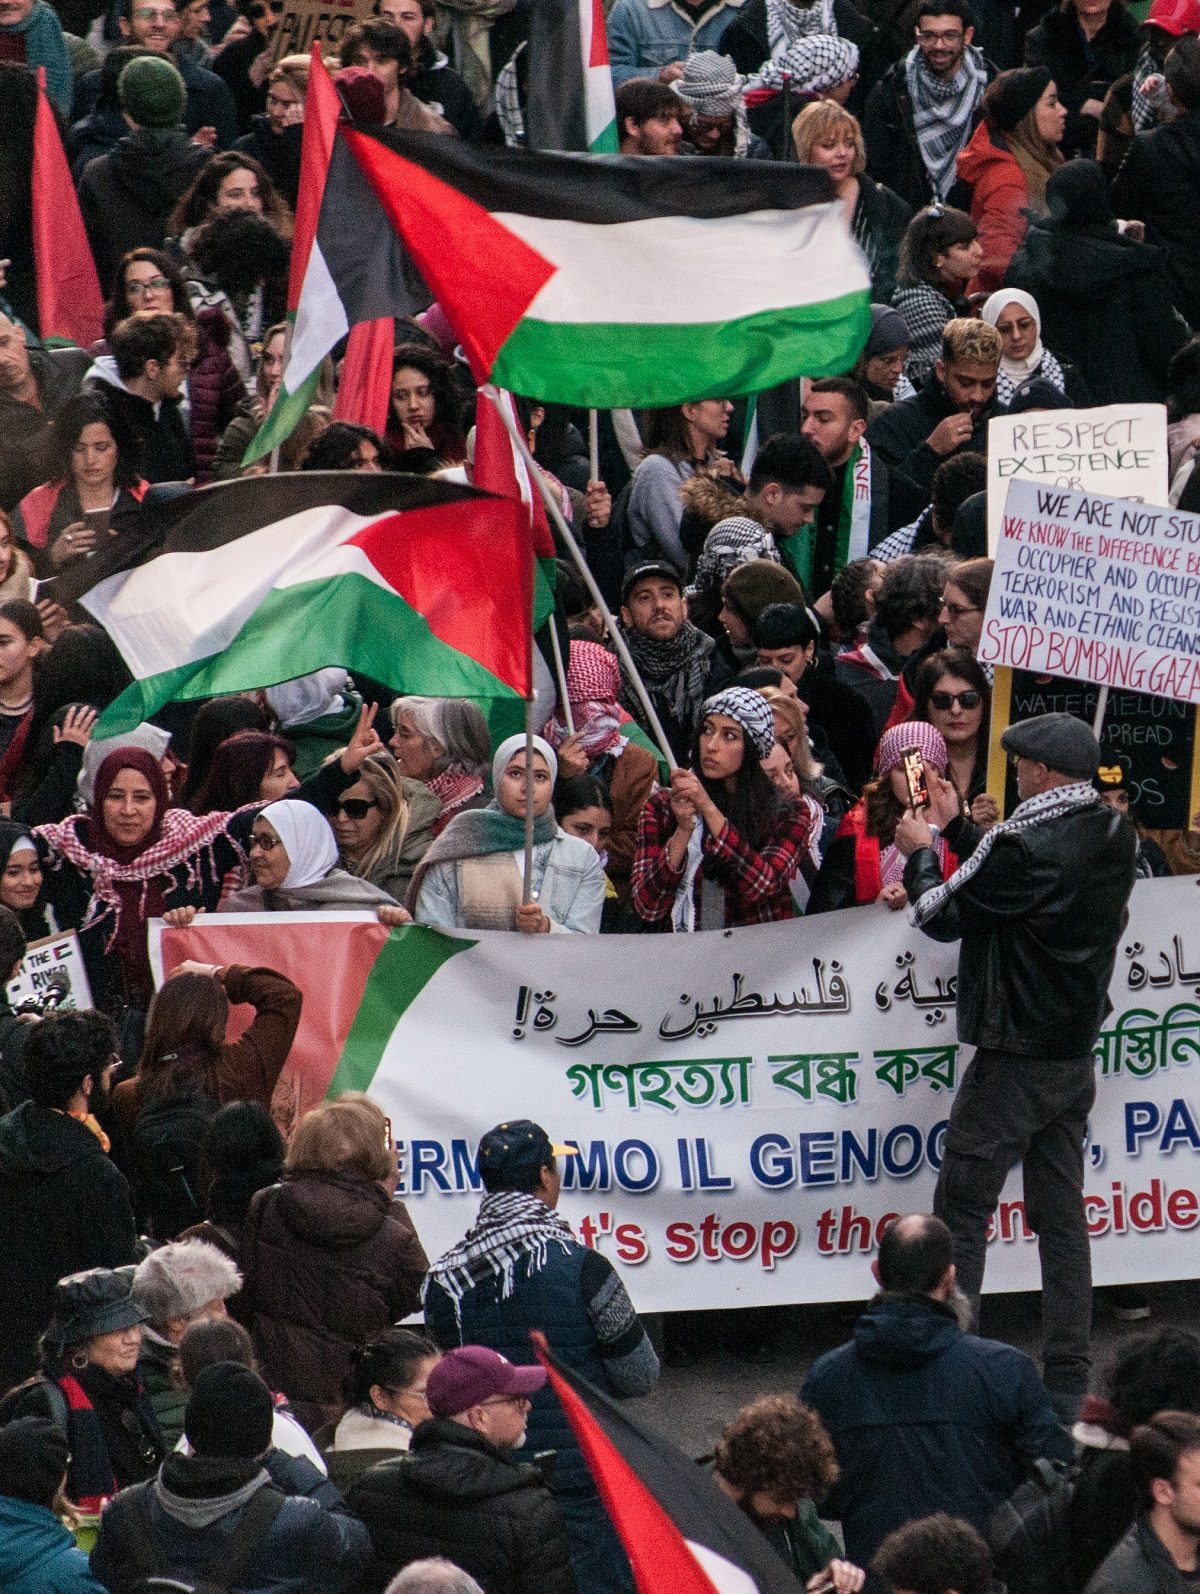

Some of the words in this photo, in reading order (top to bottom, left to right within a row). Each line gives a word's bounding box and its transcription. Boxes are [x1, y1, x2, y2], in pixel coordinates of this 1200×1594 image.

[1012, 418, 1142, 451] RESPECT
[998, 449, 1155, 477] EXISTENCE
[1036, 489, 1071, 517] WE
[1074, 497, 1114, 528] ARE
[1120, 511, 1163, 537] NOT
[1002, 515, 1023, 541] WE
[1029, 520, 1071, 547] KNOW
[1070, 531, 1094, 553] THE
[1098, 535, 1180, 570] DIFFERENCE
[1017, 545, 1097, 581] OCCUPIER
[1104, 565, 1138, 590] AND
[1001, 570, 1101, 608] TERRORISM
[1109, 592, 1144, 617] AND
[999, 595, 1038, 625] WAR
[1044, 607, 1077, 628] AND
[1078, 610, 1143, 643] ETHNIC
[981, 619, 1043, 668] STOP
[1046, 632, 1149, 688] BOMBING
[1099, 723, 1172, 746] PREAD
[28, 950, 50, 967] THE
[658, 957, 849, 1041] فلسطين
[566, 1056, 752, 1111] গণহত্যা
[768, 1052, 859, 1103] বন্ধ
[677, 1137, 732, 1188] IL
[665, 1212, 797, 1268] stop
